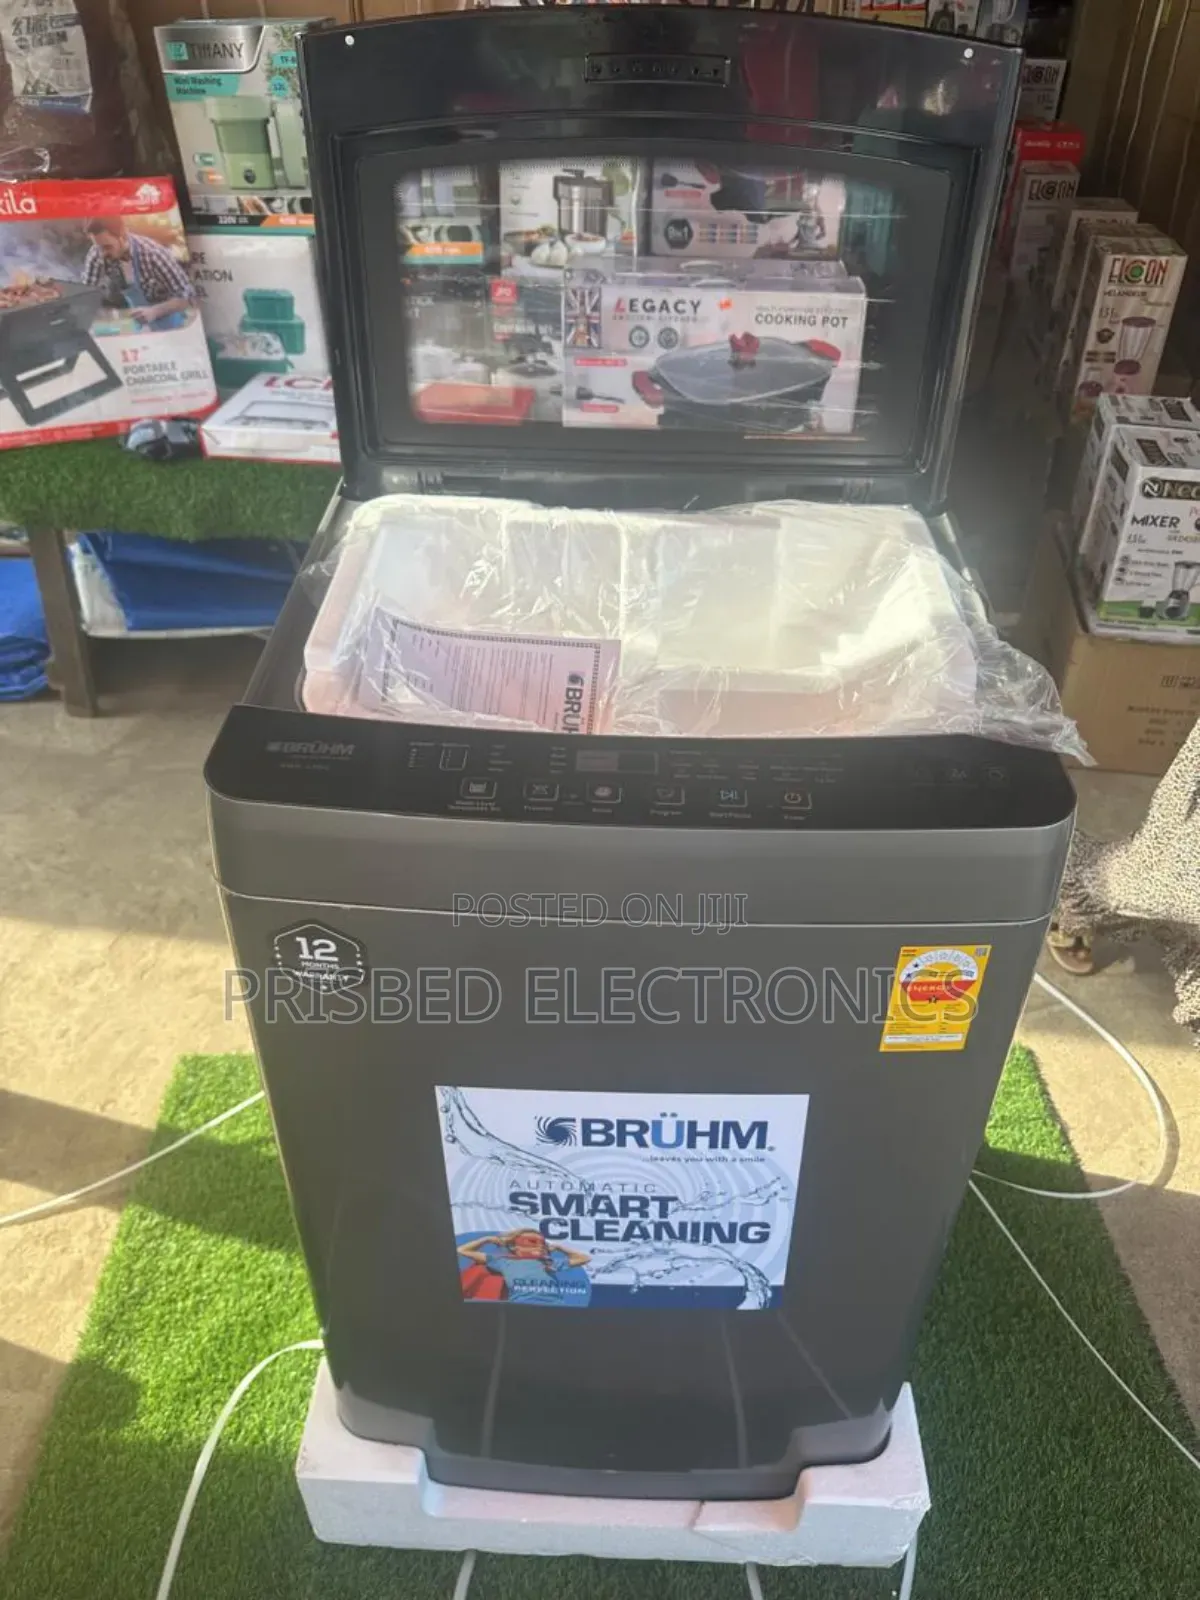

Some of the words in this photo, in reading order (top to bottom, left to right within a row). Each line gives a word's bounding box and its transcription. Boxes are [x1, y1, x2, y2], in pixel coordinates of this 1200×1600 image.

[189, 42, 244, 59] TIFFANY
[614, 298, 701, 315] LEGACY
[755, 313, 817, 327] COOKING
[821, 316, 849, 329] POT
[123, 361, 177, 375] PORTABLE
[1131, 514, 1181, 528] MIXER
[296, 937, 339, 962] 12
[301, 961, 340, 970] MONTHS
[580, 1112, 770, 1150] BRÜHM
[683, 1156, 703, 1164] you
[705, 1155, 728, 1163] with
[739, 1155, 766, 1163] smile
[509, 1180, 657, 1194] AUTOMATIC
[509, 1192, 680, 1219] SMART
[539, 1218, 771, 1245] CLEANING
[513, 1279, 586, 1287] CLEANING
